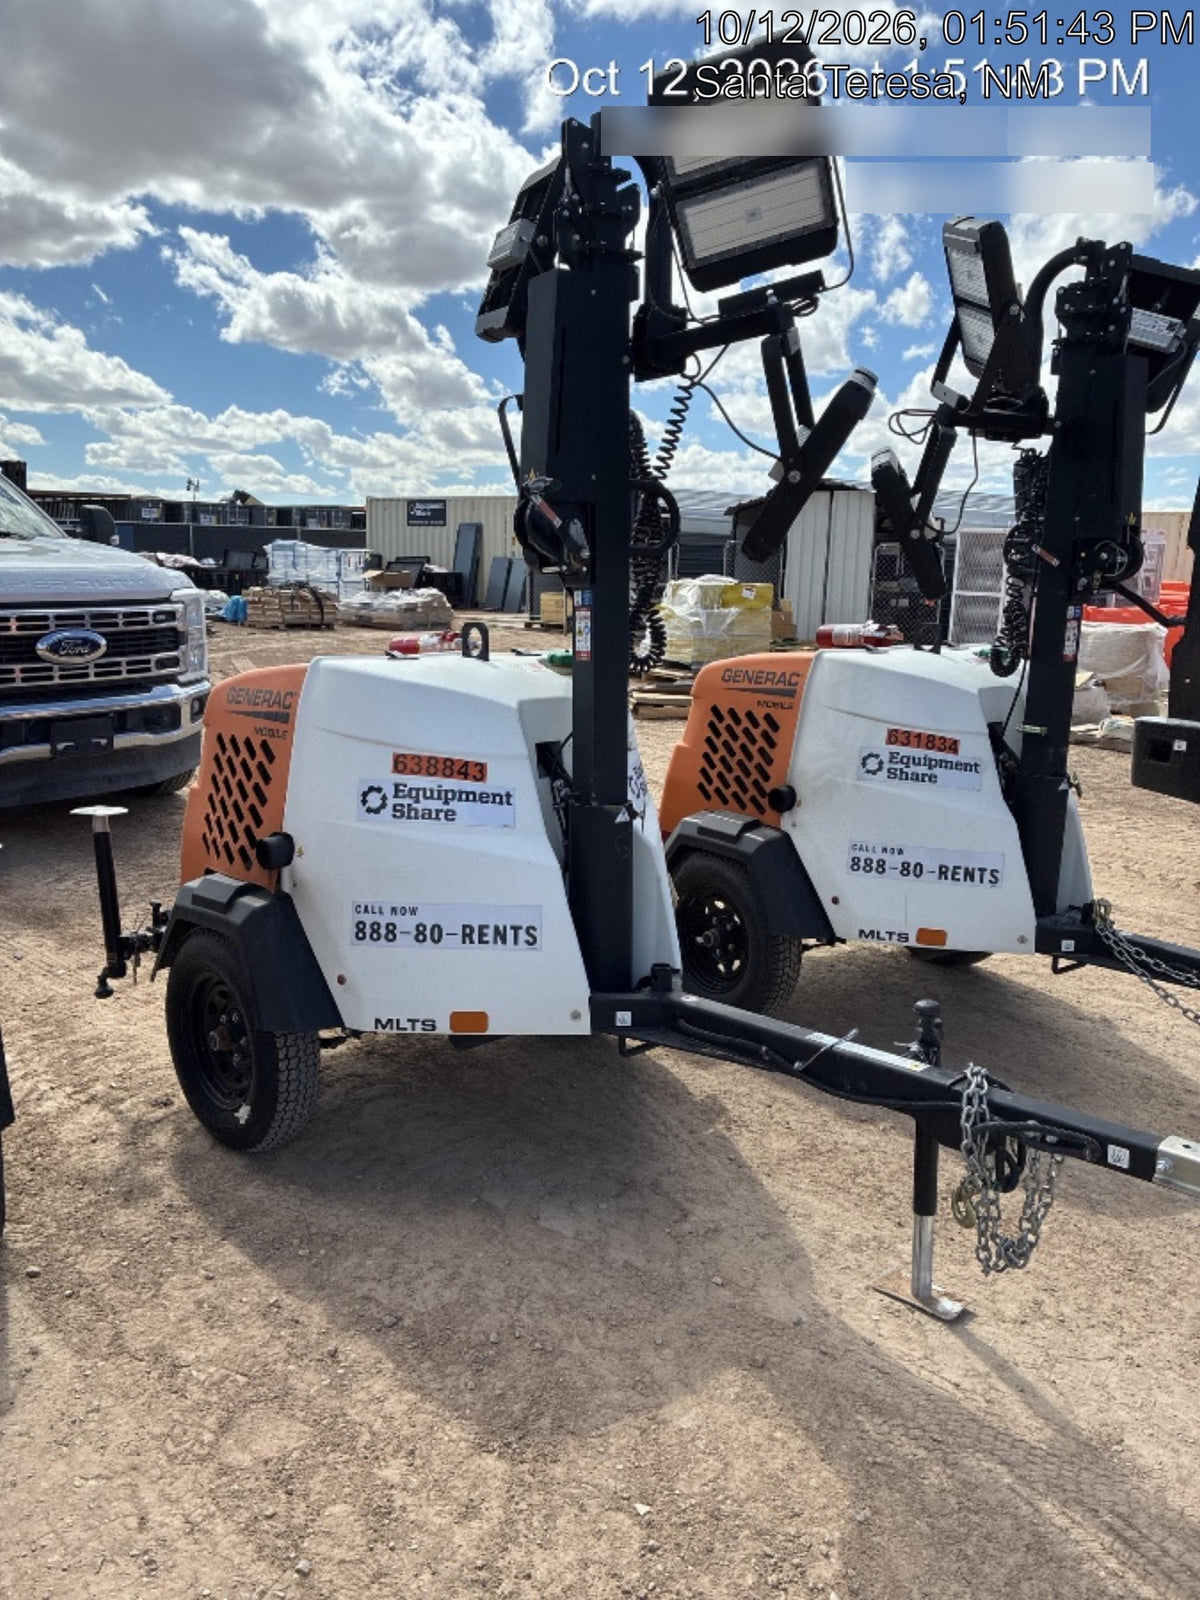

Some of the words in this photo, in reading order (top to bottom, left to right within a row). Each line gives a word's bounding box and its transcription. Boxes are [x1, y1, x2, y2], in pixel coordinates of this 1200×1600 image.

[59, 639, 91, 655] Ford
[721, 668, 800, 687] GENERAC
[227, 686, 294, 710] GENERAC
[887, 728, 959, 754] 631834
[393, 753, 485, 782] 638843
[887, 751, 980, 774] Equipment
[886, 767, 938, 784] Share
[392, 782, 513, 806] Equipment
[391, 803, 457, 822] Share
[851, 843, 877, 854] CALL
[850, 856, 1000, 885] 888-80-RENTS
[355, 904, 384, 915] CALL
[391, 906, 419, 916] NOW
[354, 920, 538, 946] 888-80-RENTS
[858, 929, 910, 943] MLTS
[374, 1018, 437, 1032] MLTS
